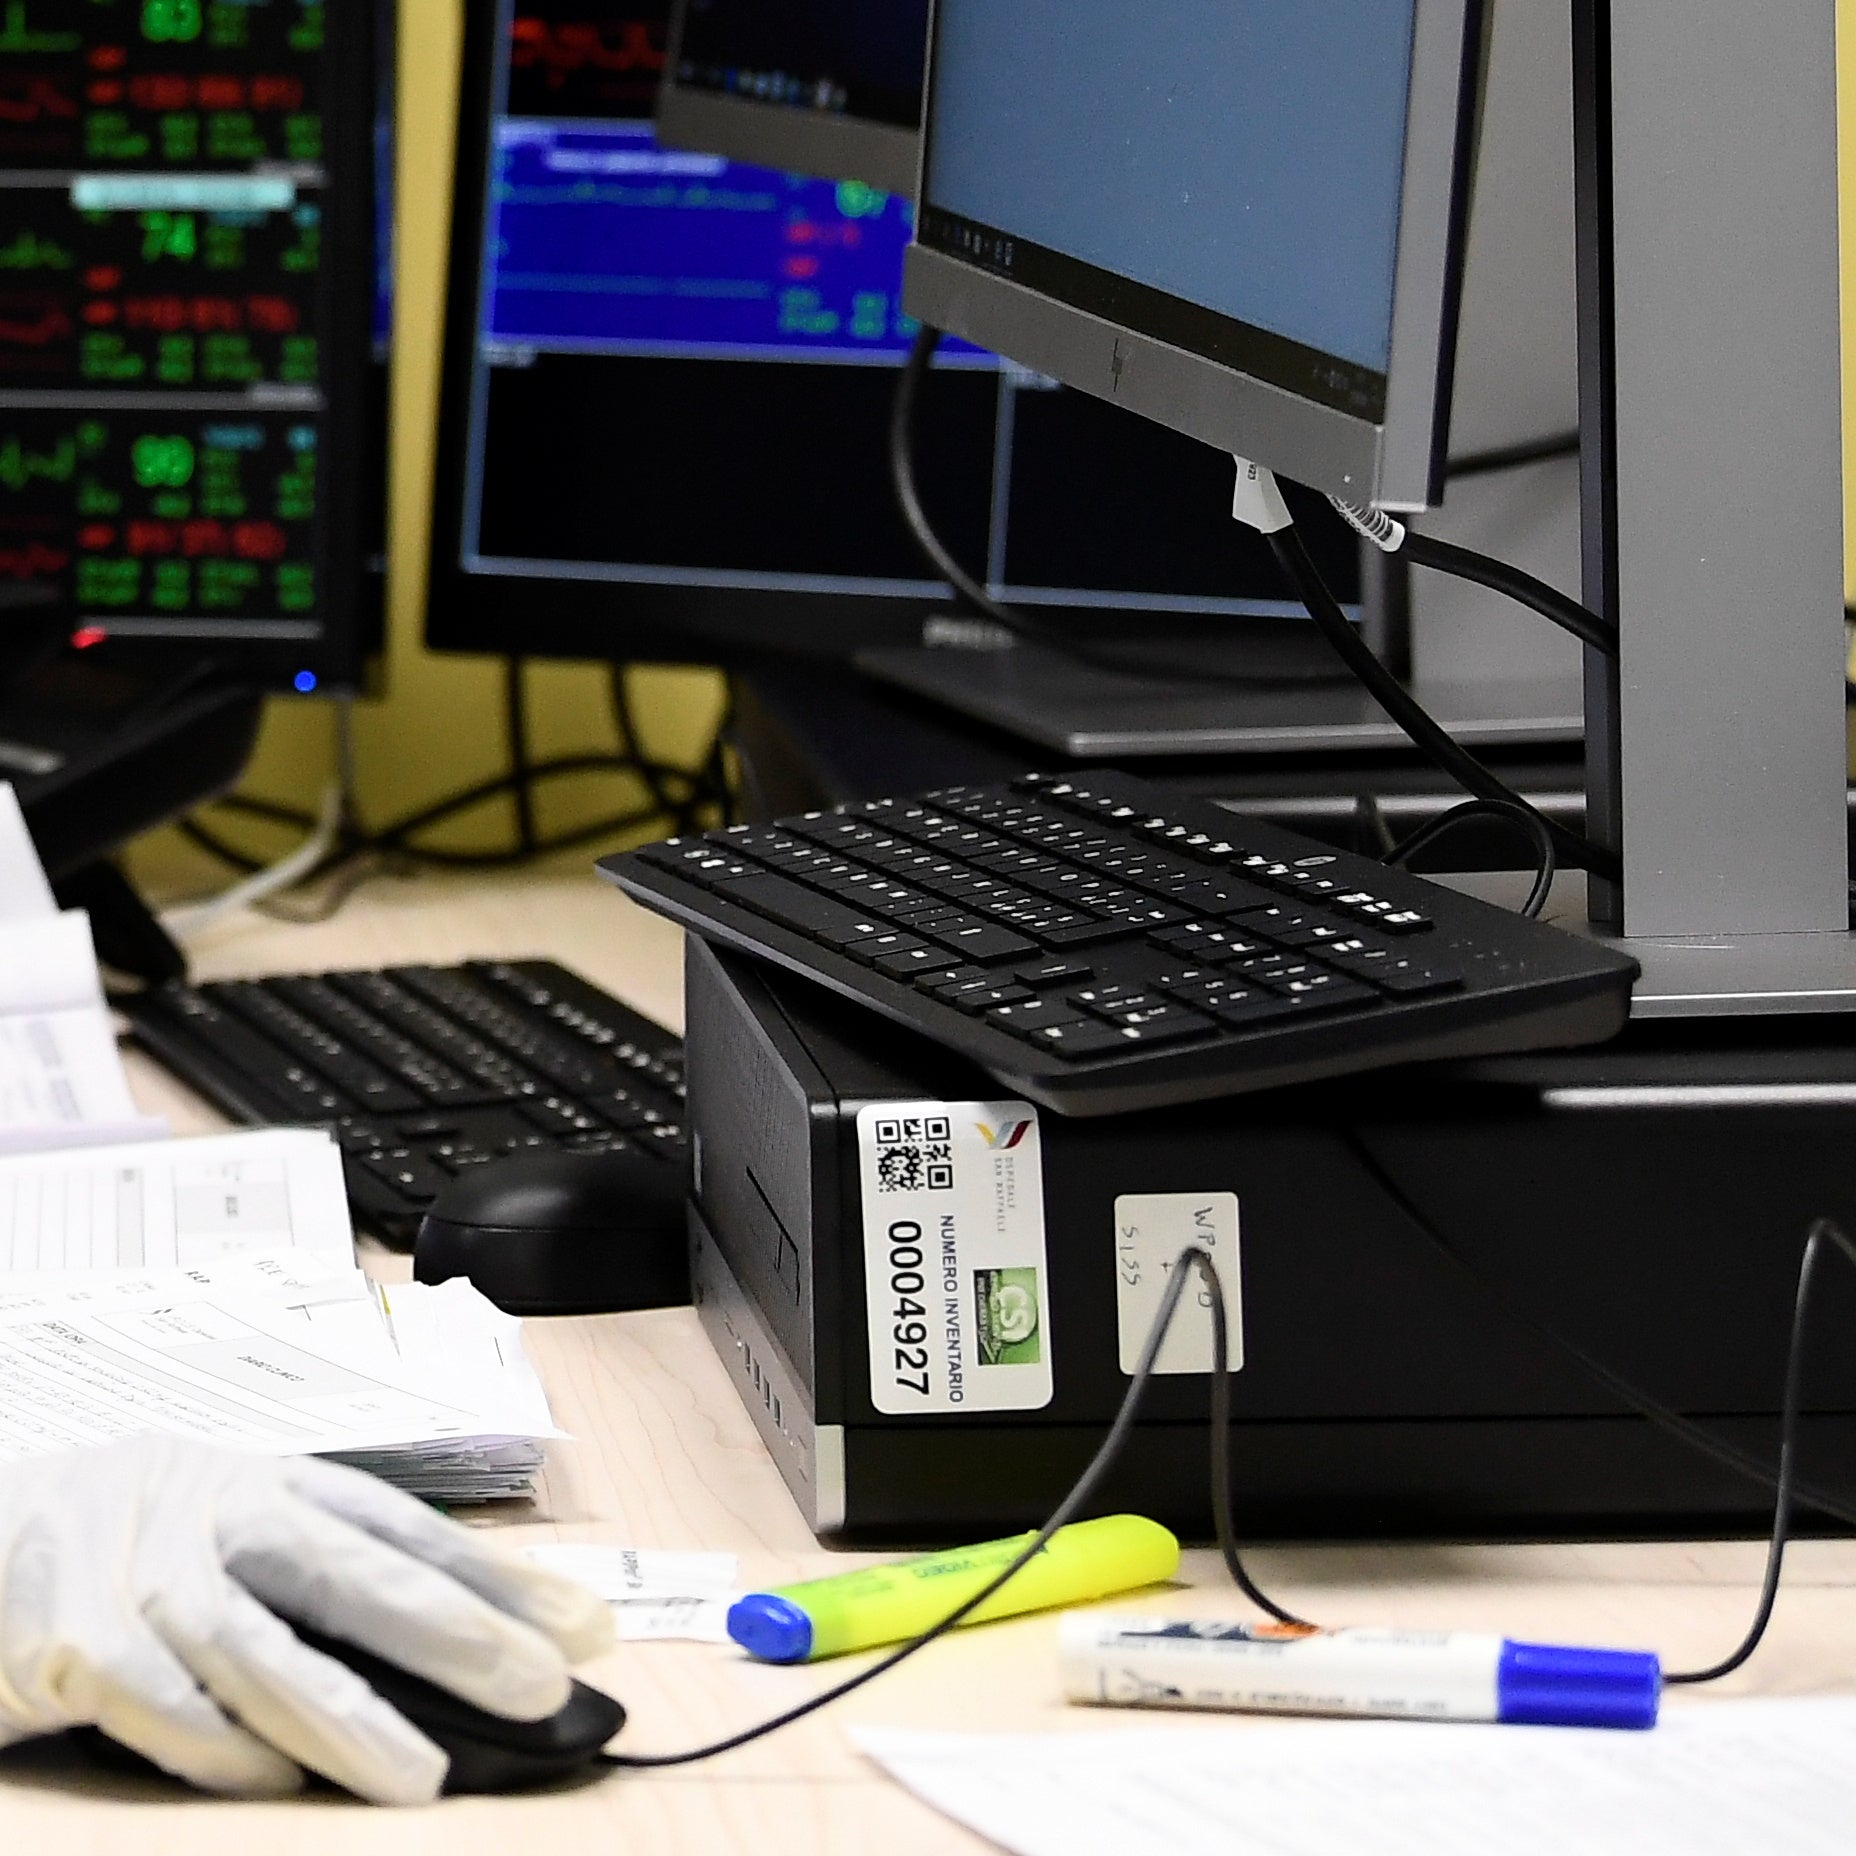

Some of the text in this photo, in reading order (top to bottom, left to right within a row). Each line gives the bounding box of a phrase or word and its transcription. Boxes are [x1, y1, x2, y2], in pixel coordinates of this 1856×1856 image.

[888, 1220, 929, 1397] 0004927
[941, 1215, 964, 1404] NUMERO INVENTARIO
[999, 1286, 1029, 1341] CSI
